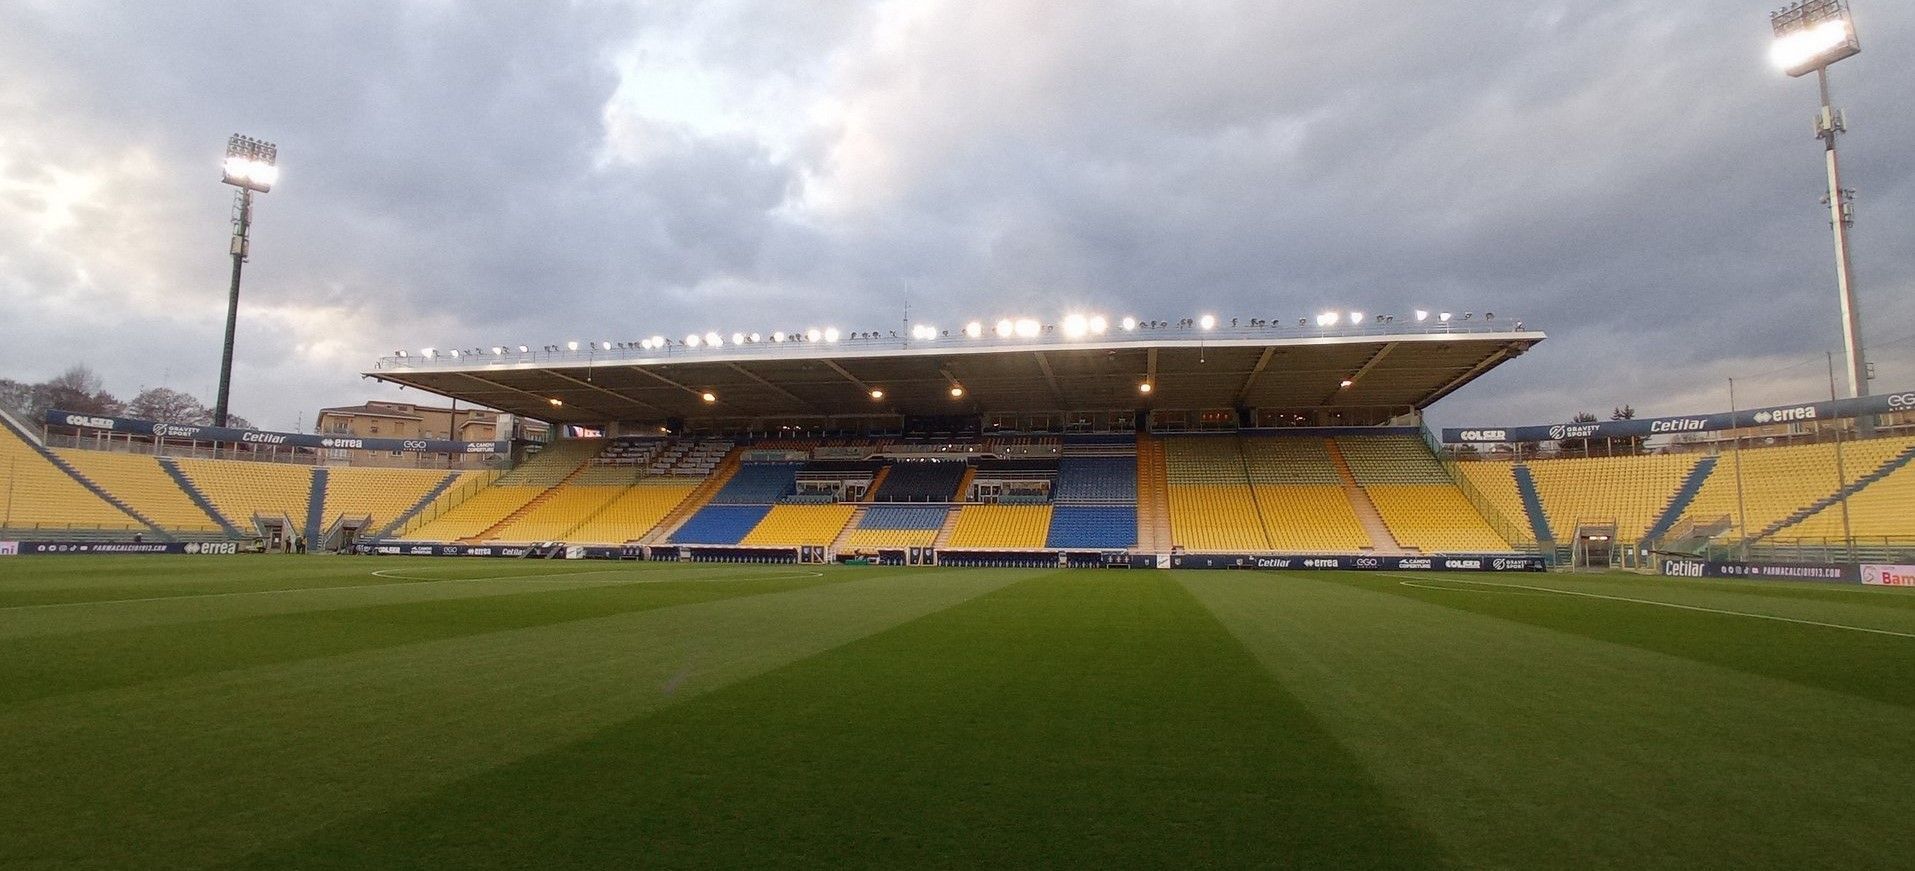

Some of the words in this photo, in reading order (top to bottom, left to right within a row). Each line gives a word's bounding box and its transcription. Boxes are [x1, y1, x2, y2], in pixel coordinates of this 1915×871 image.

[1772, 406, 1816, 422] errea
[1651, 418, 1707, 432] Cetilar
[242, 432, 286, 444] Cetilar
[201, 542, 236, 554] errea
[1257, 558, 1291, 567] Cetilar
[1665, 560, 1704, 577] Cetilar
